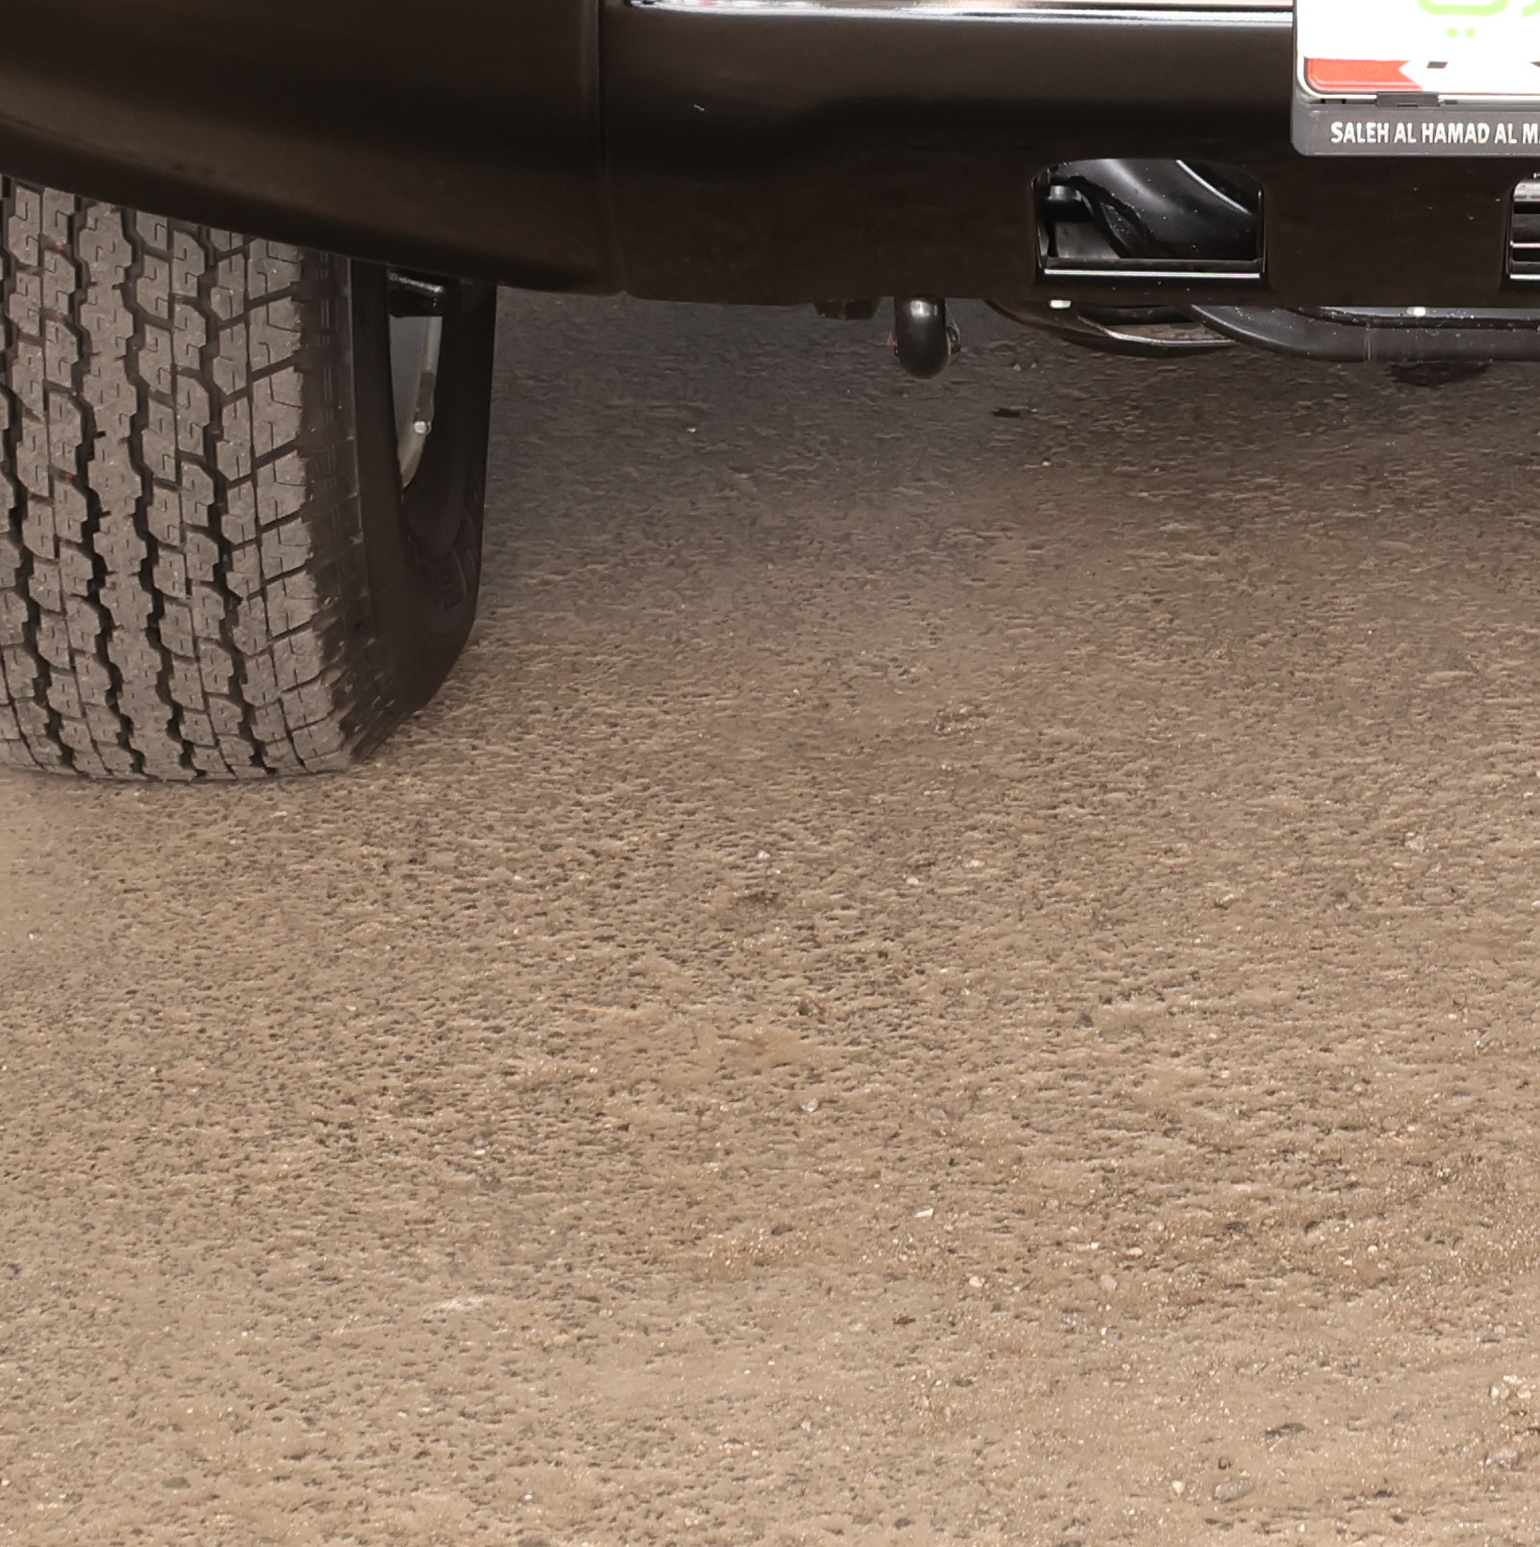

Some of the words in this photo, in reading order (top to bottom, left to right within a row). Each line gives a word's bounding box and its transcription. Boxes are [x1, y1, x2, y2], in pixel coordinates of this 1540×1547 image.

[1330, 121, 1390, 144] SALEH
[1393, 122, 1417, 144] AL
[1421, 122, 1491, 144] HAMAD
[1494, 122, 1518, 144] AL
